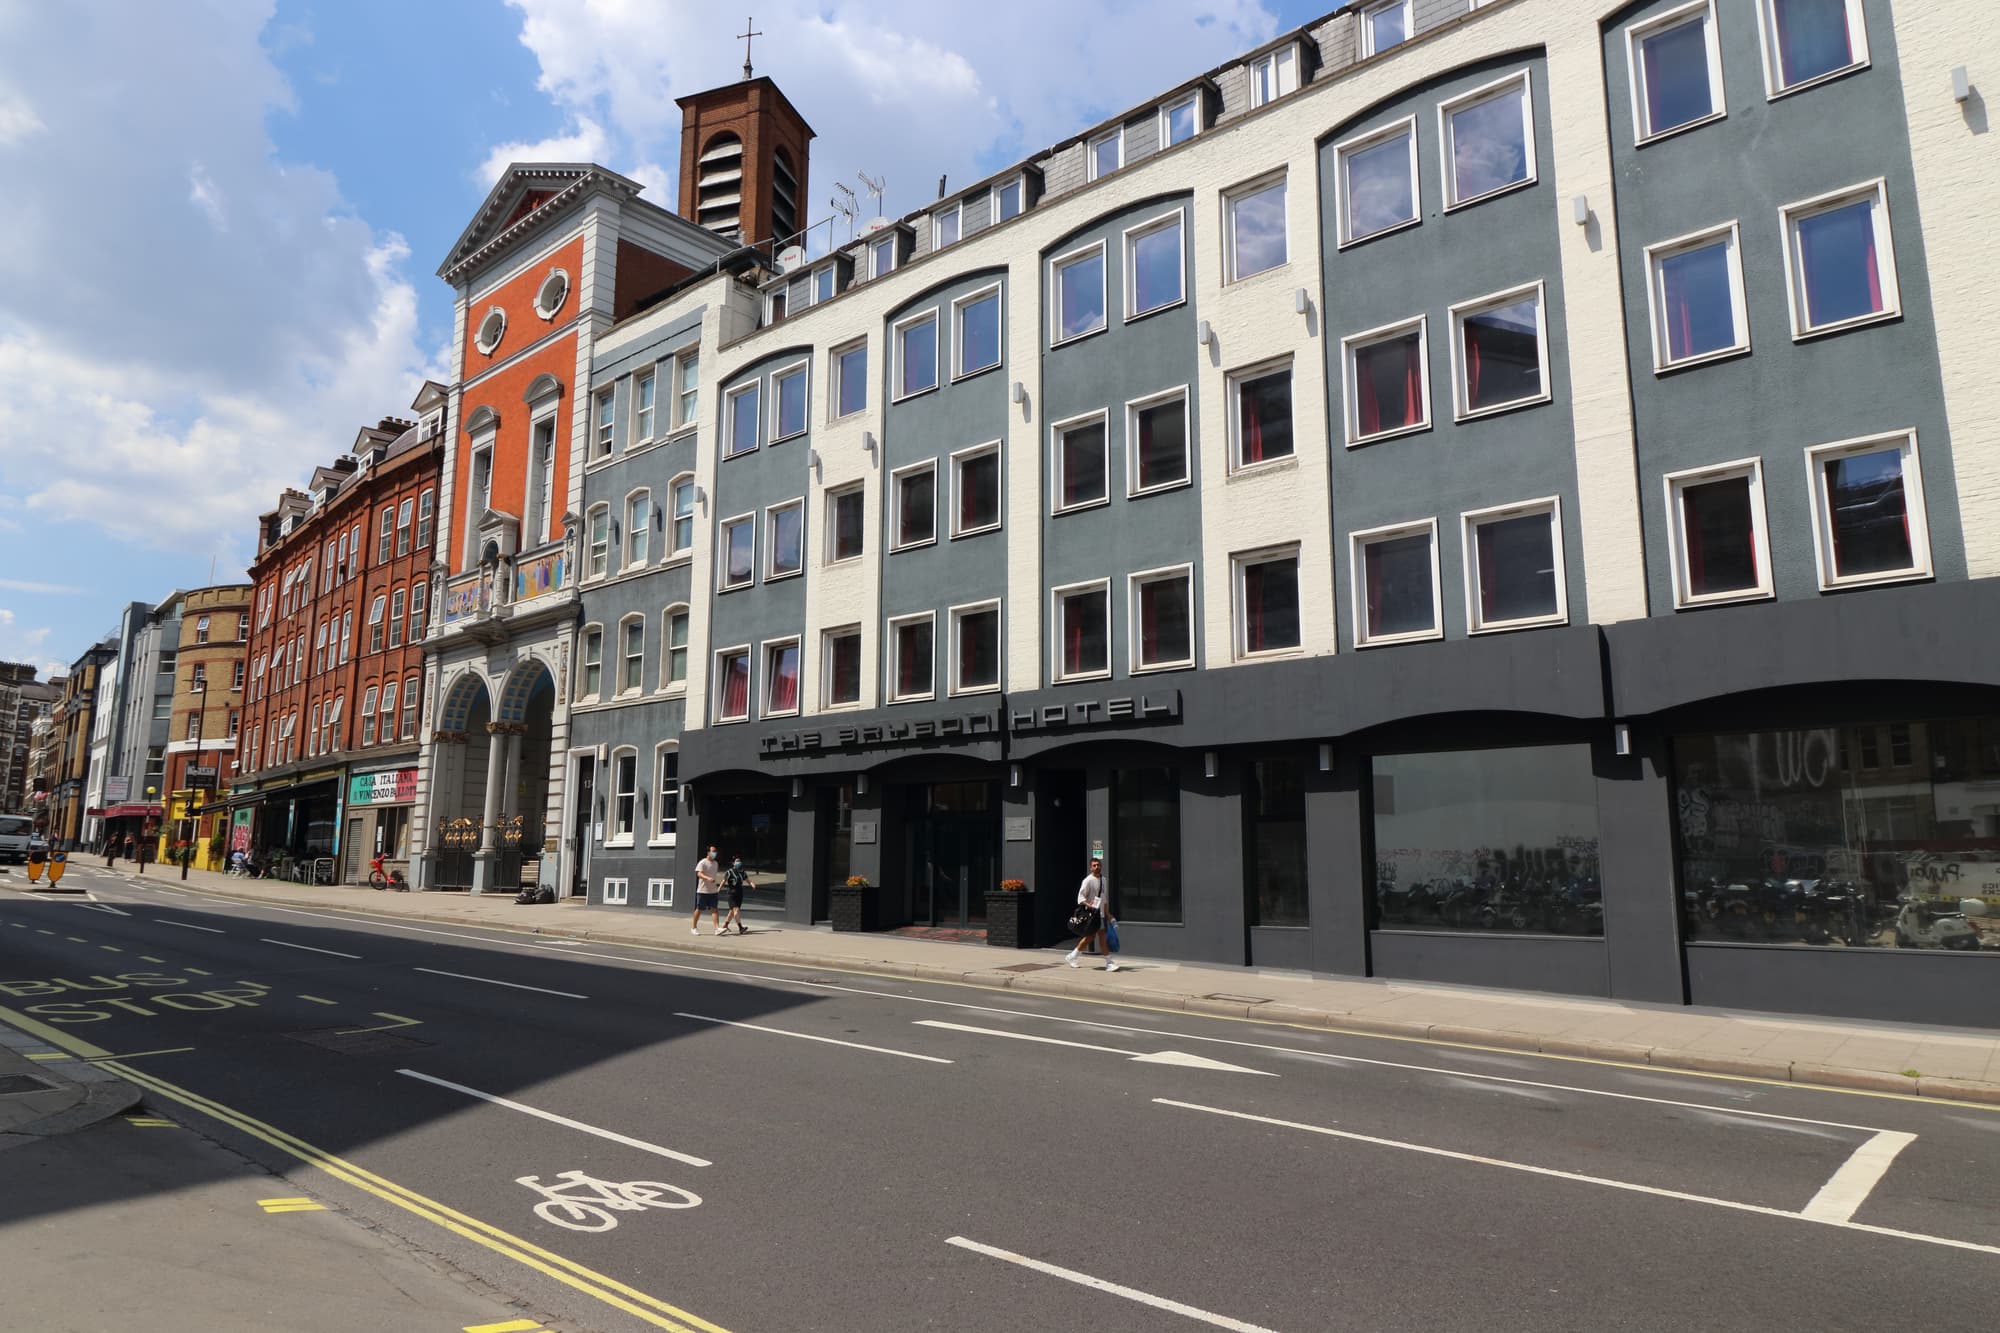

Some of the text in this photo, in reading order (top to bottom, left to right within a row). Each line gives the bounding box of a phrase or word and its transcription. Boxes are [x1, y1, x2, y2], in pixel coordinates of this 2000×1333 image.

[762, 734, 821, 752] THE
[1012, 695, 1168, 725] HOTEL
[360, 772, 413, 787] CASA ITALIANA
[0, 972, 188, 997] BUS
[24, 988, 268, 1023] STOP
